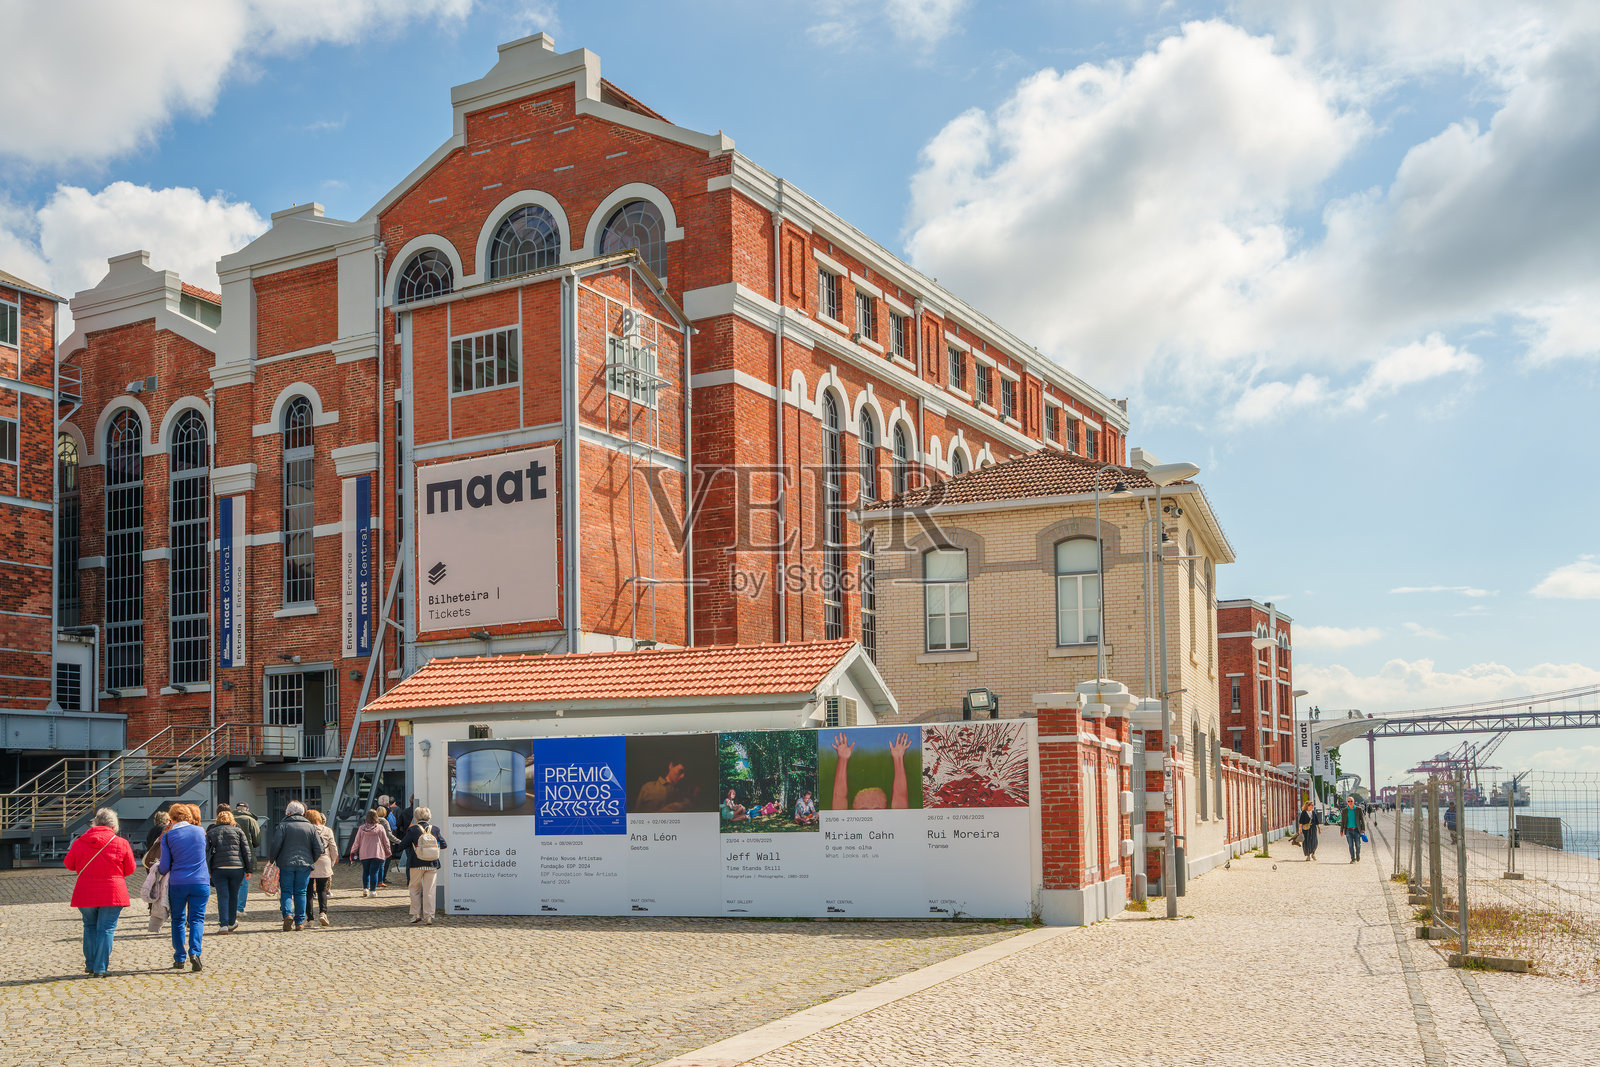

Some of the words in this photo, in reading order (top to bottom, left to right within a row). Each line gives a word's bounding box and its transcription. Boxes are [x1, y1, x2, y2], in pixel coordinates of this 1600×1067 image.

[427, 460, 546, 514] maat
[429, 590, 489, 605] Bilheteira
[429, 608, 470, 620] Tickets
[545, 763, 613, 782] PRÉMIO
[545, 784, 611, 800] NOVOS
[540, 800, 619, 816] ARTISTAS
[654, 833, 677, 841] Léon
[825, 832, 863, 840] Miriam
[869, 831, 894, 840] Cahn
[928, 830, 947, 838] Rui
[954, 830, 999, 838] Moreira
[463, 848, 500, 856] Fábrica
[726, 852, 750, 861] Jeff
[757, 852, 780, 860] Wall
